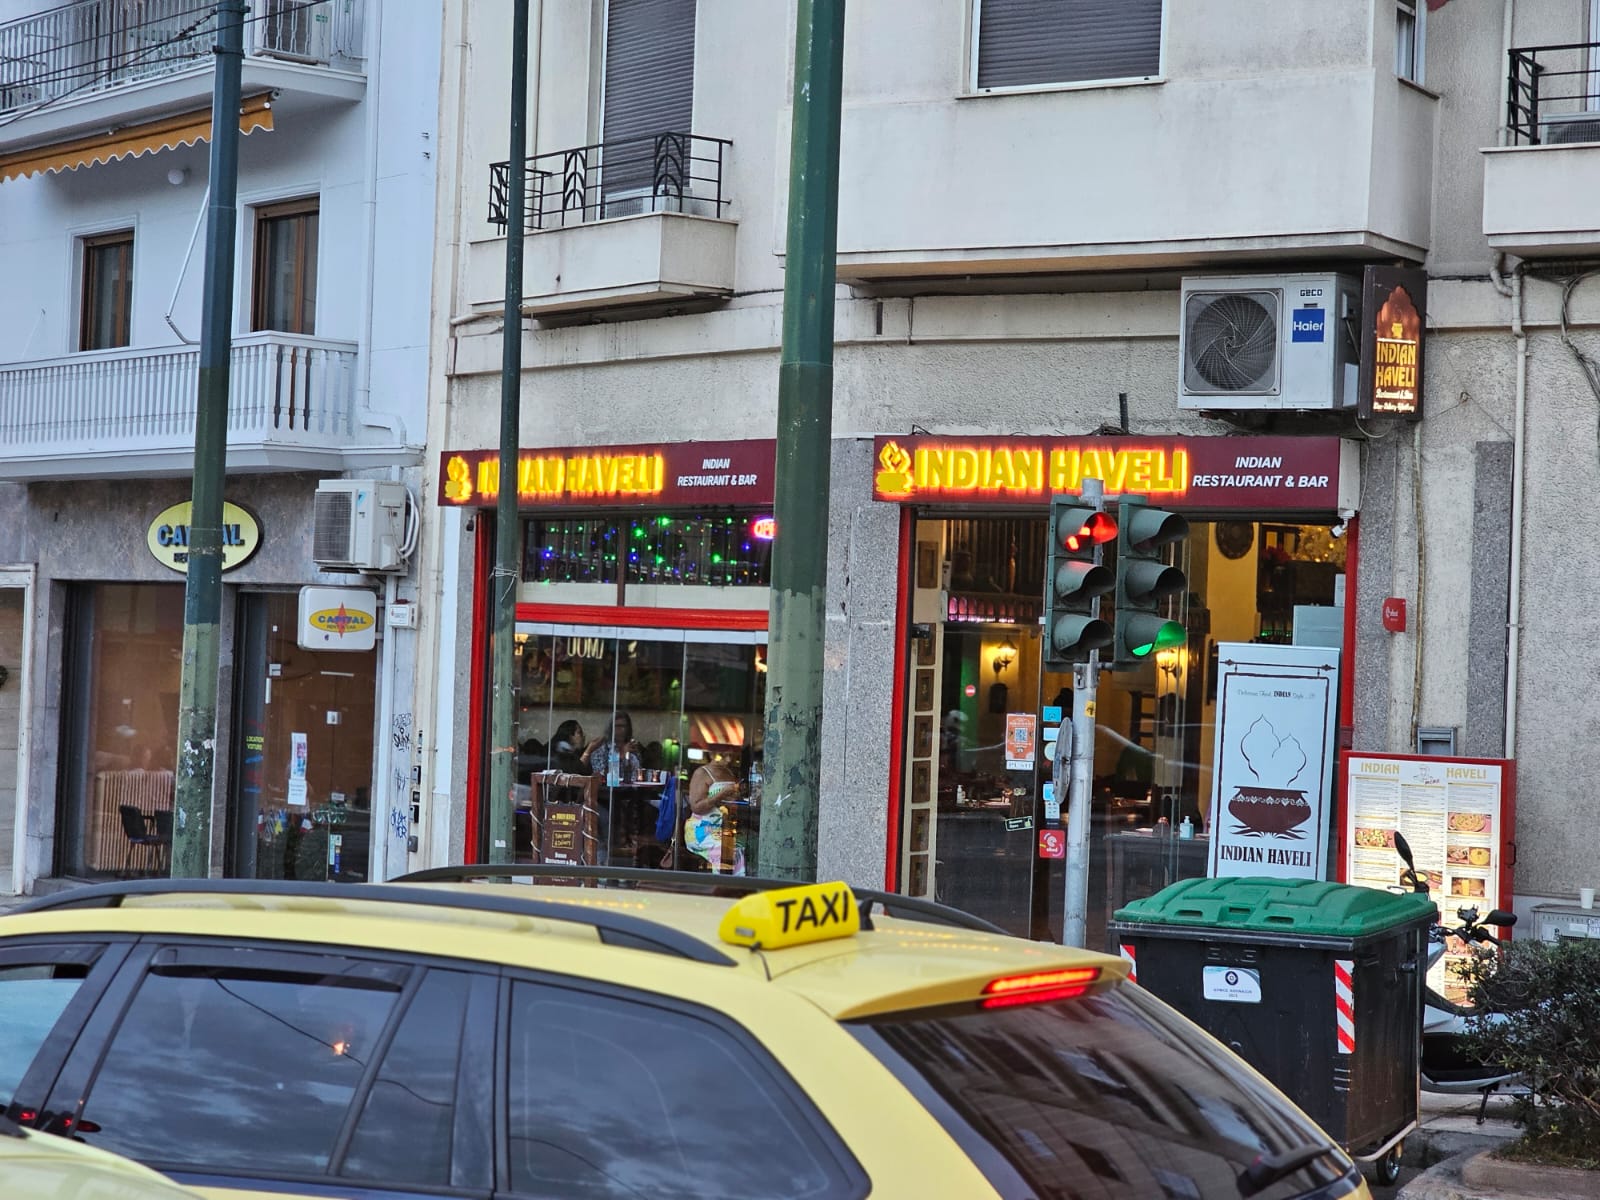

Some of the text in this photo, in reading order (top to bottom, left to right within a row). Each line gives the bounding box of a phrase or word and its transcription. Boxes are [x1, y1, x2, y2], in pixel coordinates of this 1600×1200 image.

[1293, 320, 1324, 331] Haier
[1376, 342, 1416, 366] INDIAN
[1375, 365, 1415, 388] HAVELI
[702, 458, 731, 470] INDIAN
[914, 447, 1188, 492] INDIAN HAVELI
[1235, 456, 1282, 469] INDIAN
[477, 454, 664, 495] INIAN HAVELI
[677, 474, 757, 487] RESTAURANT & BAR
[1192, 475, 1329, 488] RESTAURANT & BAR
[317, 614, 367, 625] CAPITAL
[1360, 761, 1488, 780] INDIAN HAVELI
[1221, 844, 1312, 867] INDIAN HAVELI
[776, 890, 849, 934] TAXI
